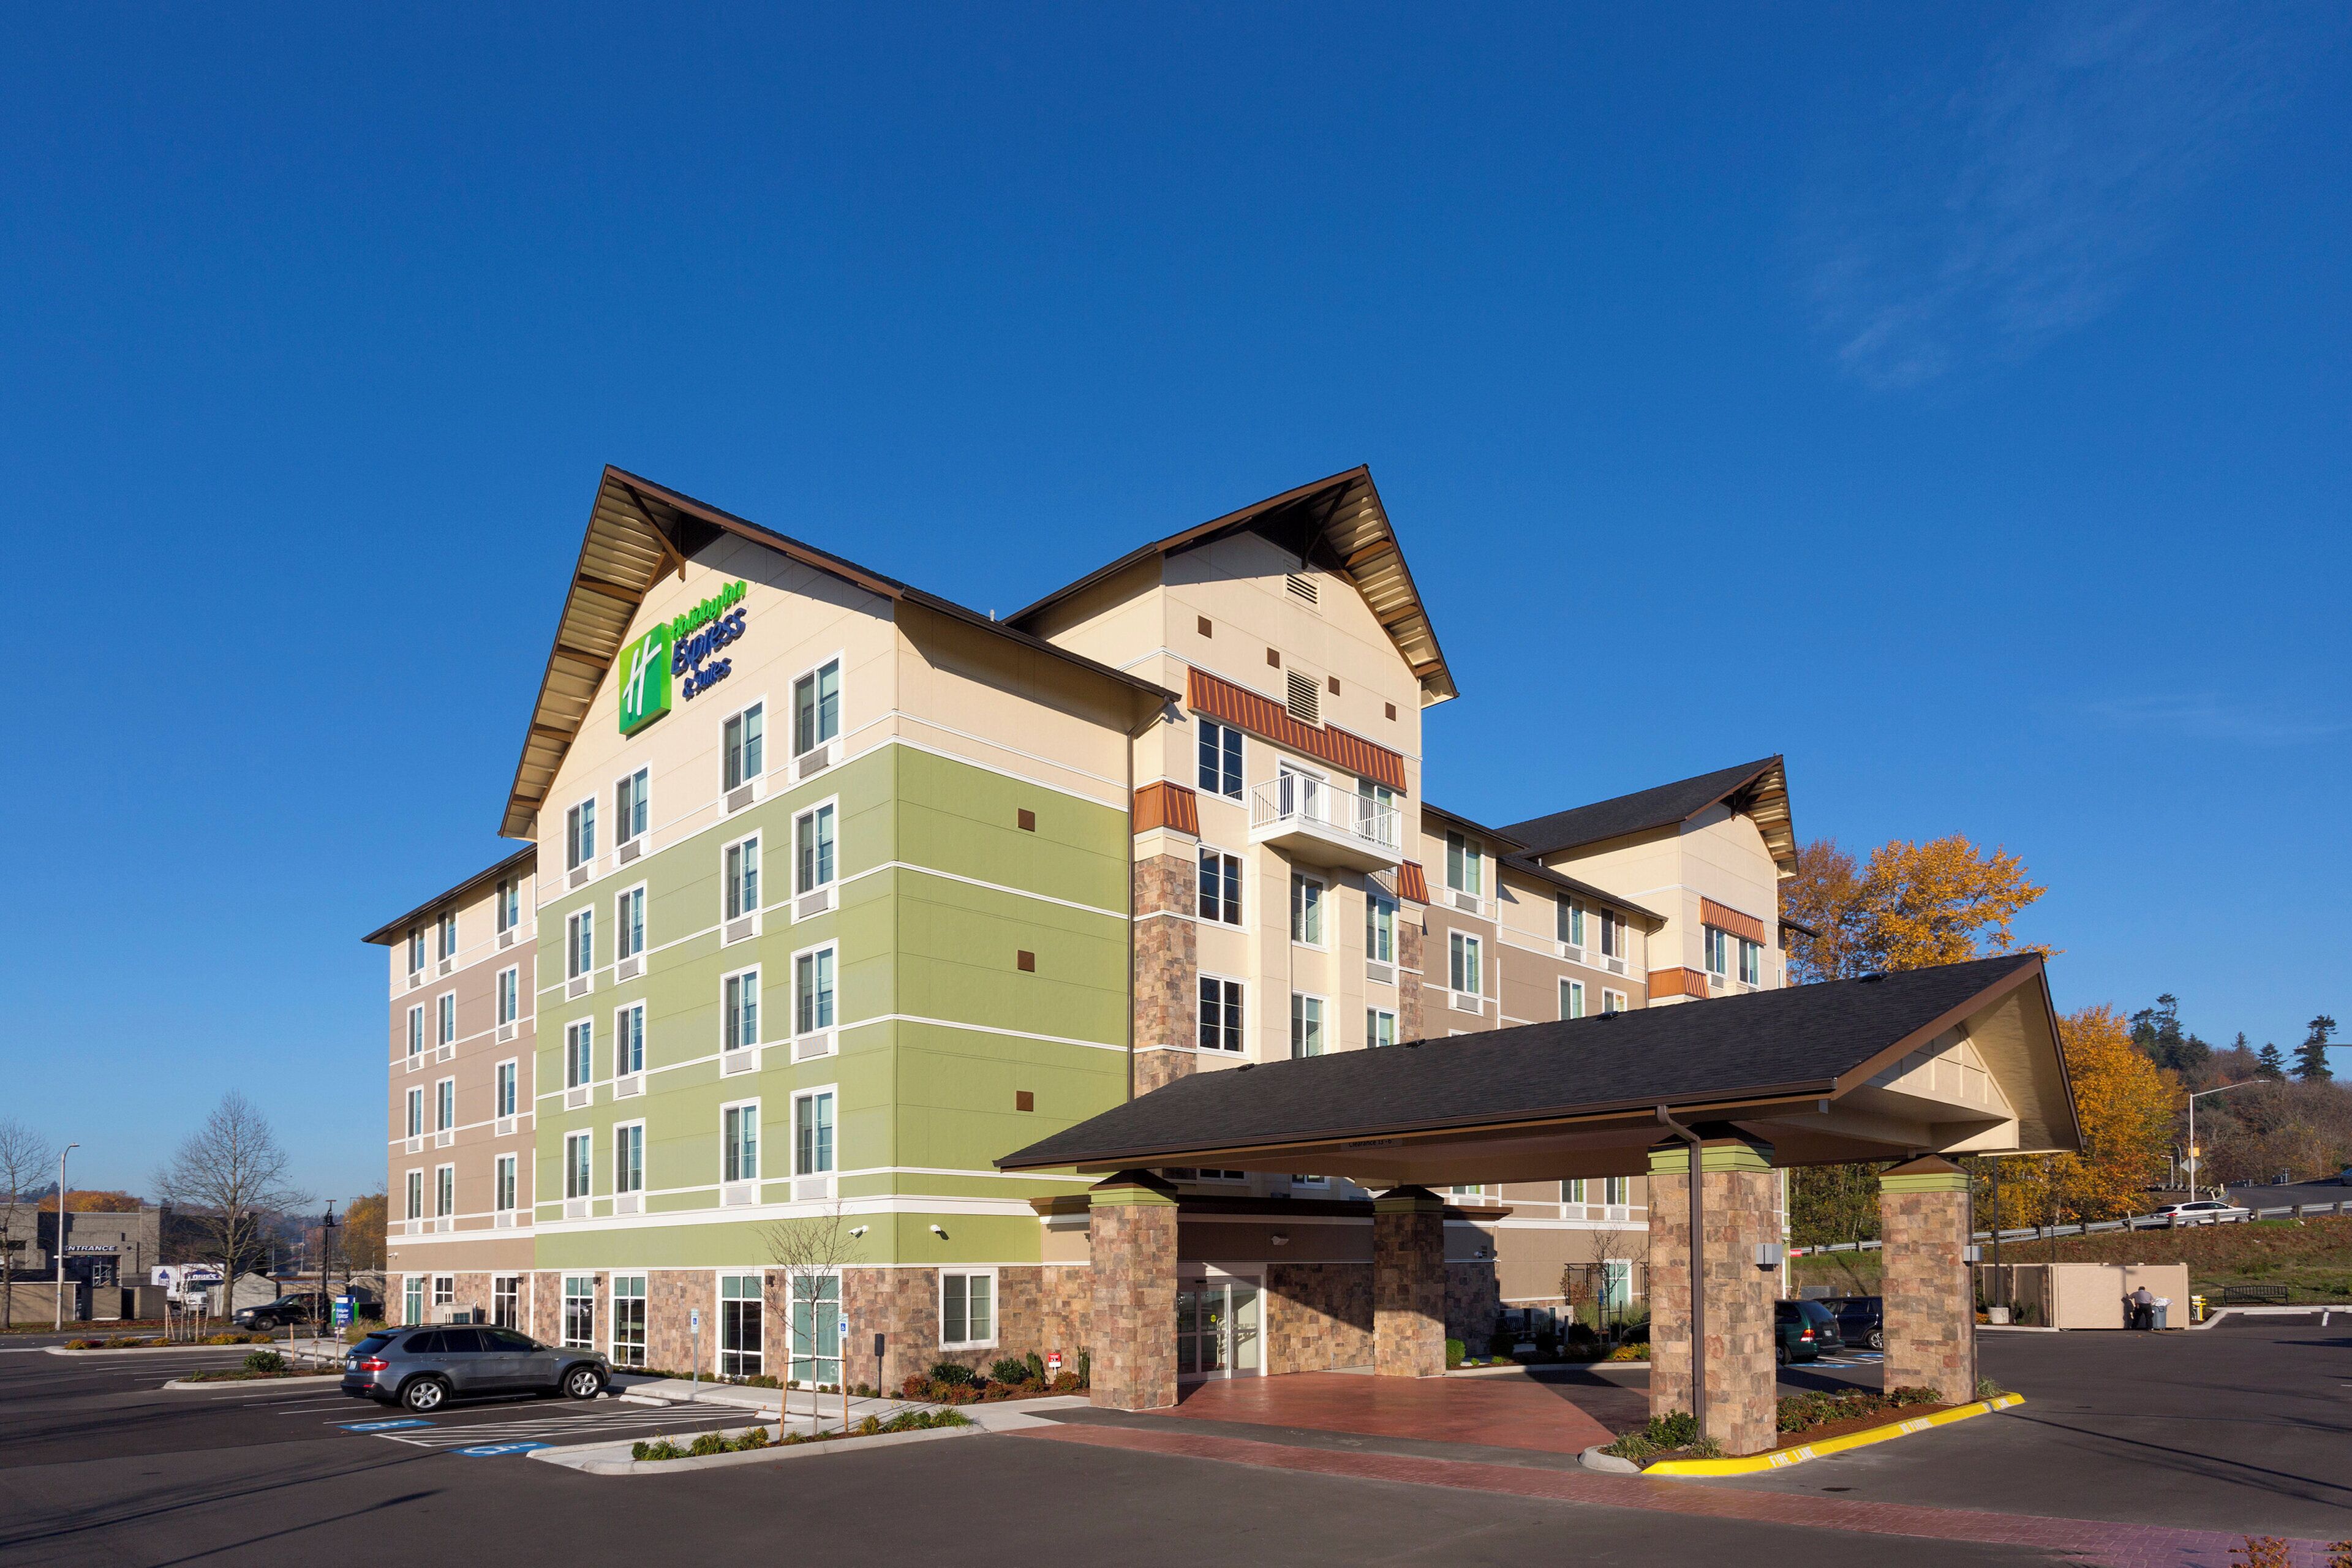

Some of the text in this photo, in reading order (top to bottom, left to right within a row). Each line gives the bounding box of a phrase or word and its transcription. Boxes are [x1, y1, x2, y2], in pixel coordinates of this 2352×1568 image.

[671, 608, 747, 675] Express
[682, 677, 695, 698] &
[1768, 1452, 1792, 1468] FIRE
